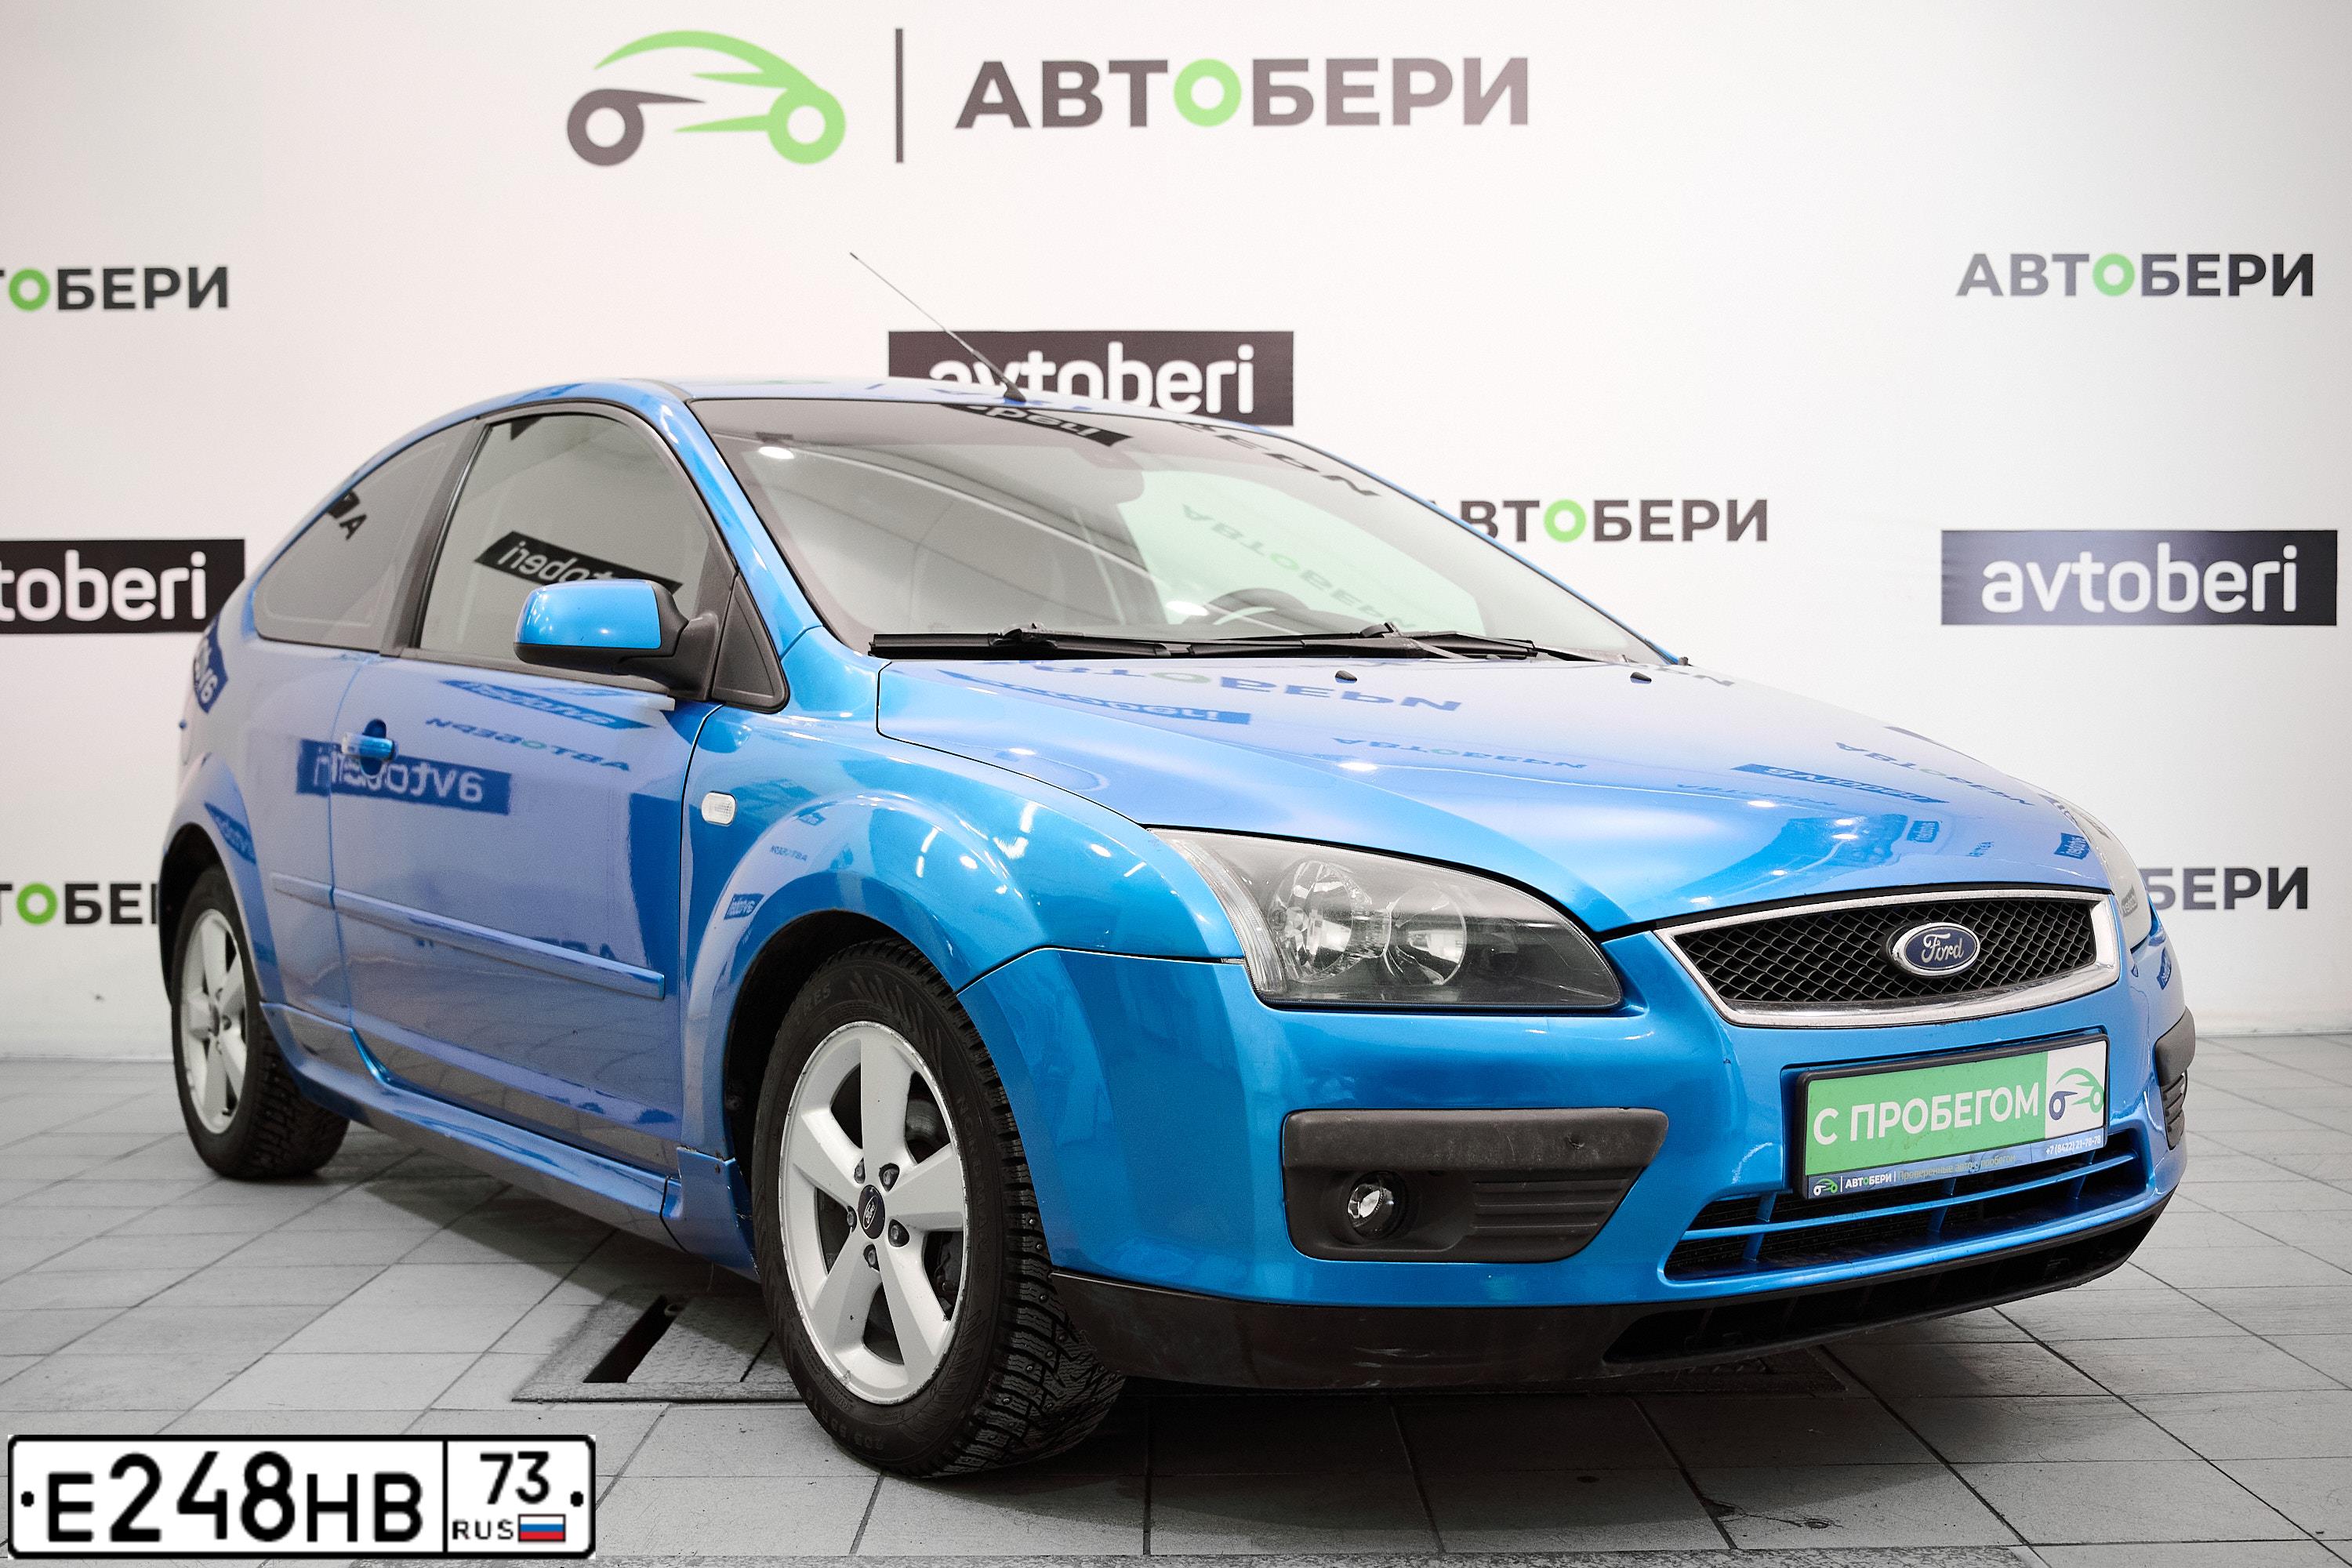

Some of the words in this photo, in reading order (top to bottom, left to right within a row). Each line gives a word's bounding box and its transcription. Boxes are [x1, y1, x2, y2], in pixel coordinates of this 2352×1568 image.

[955, 57, 1529, 129] АВТОБЕРИ
[0, 267, 229, 310] ОБЕРИ
[1956, 252, 2314, 297] АВТОБЕРИ
[1430, 499, 1768, 543] ВТОБЕРИ
[1981, 543, 2298, 613] avtoberi
[0, 884, 158, 924] ОБЕ
[1921, 933, 1964, 963] Ford
[1813, 1108, 1838, 1145] С
[1849, 1082, 2040, 1142] ПРОБЕГОМ
[1845, 1173, 1892, 1189] АВТОБЕРИ
